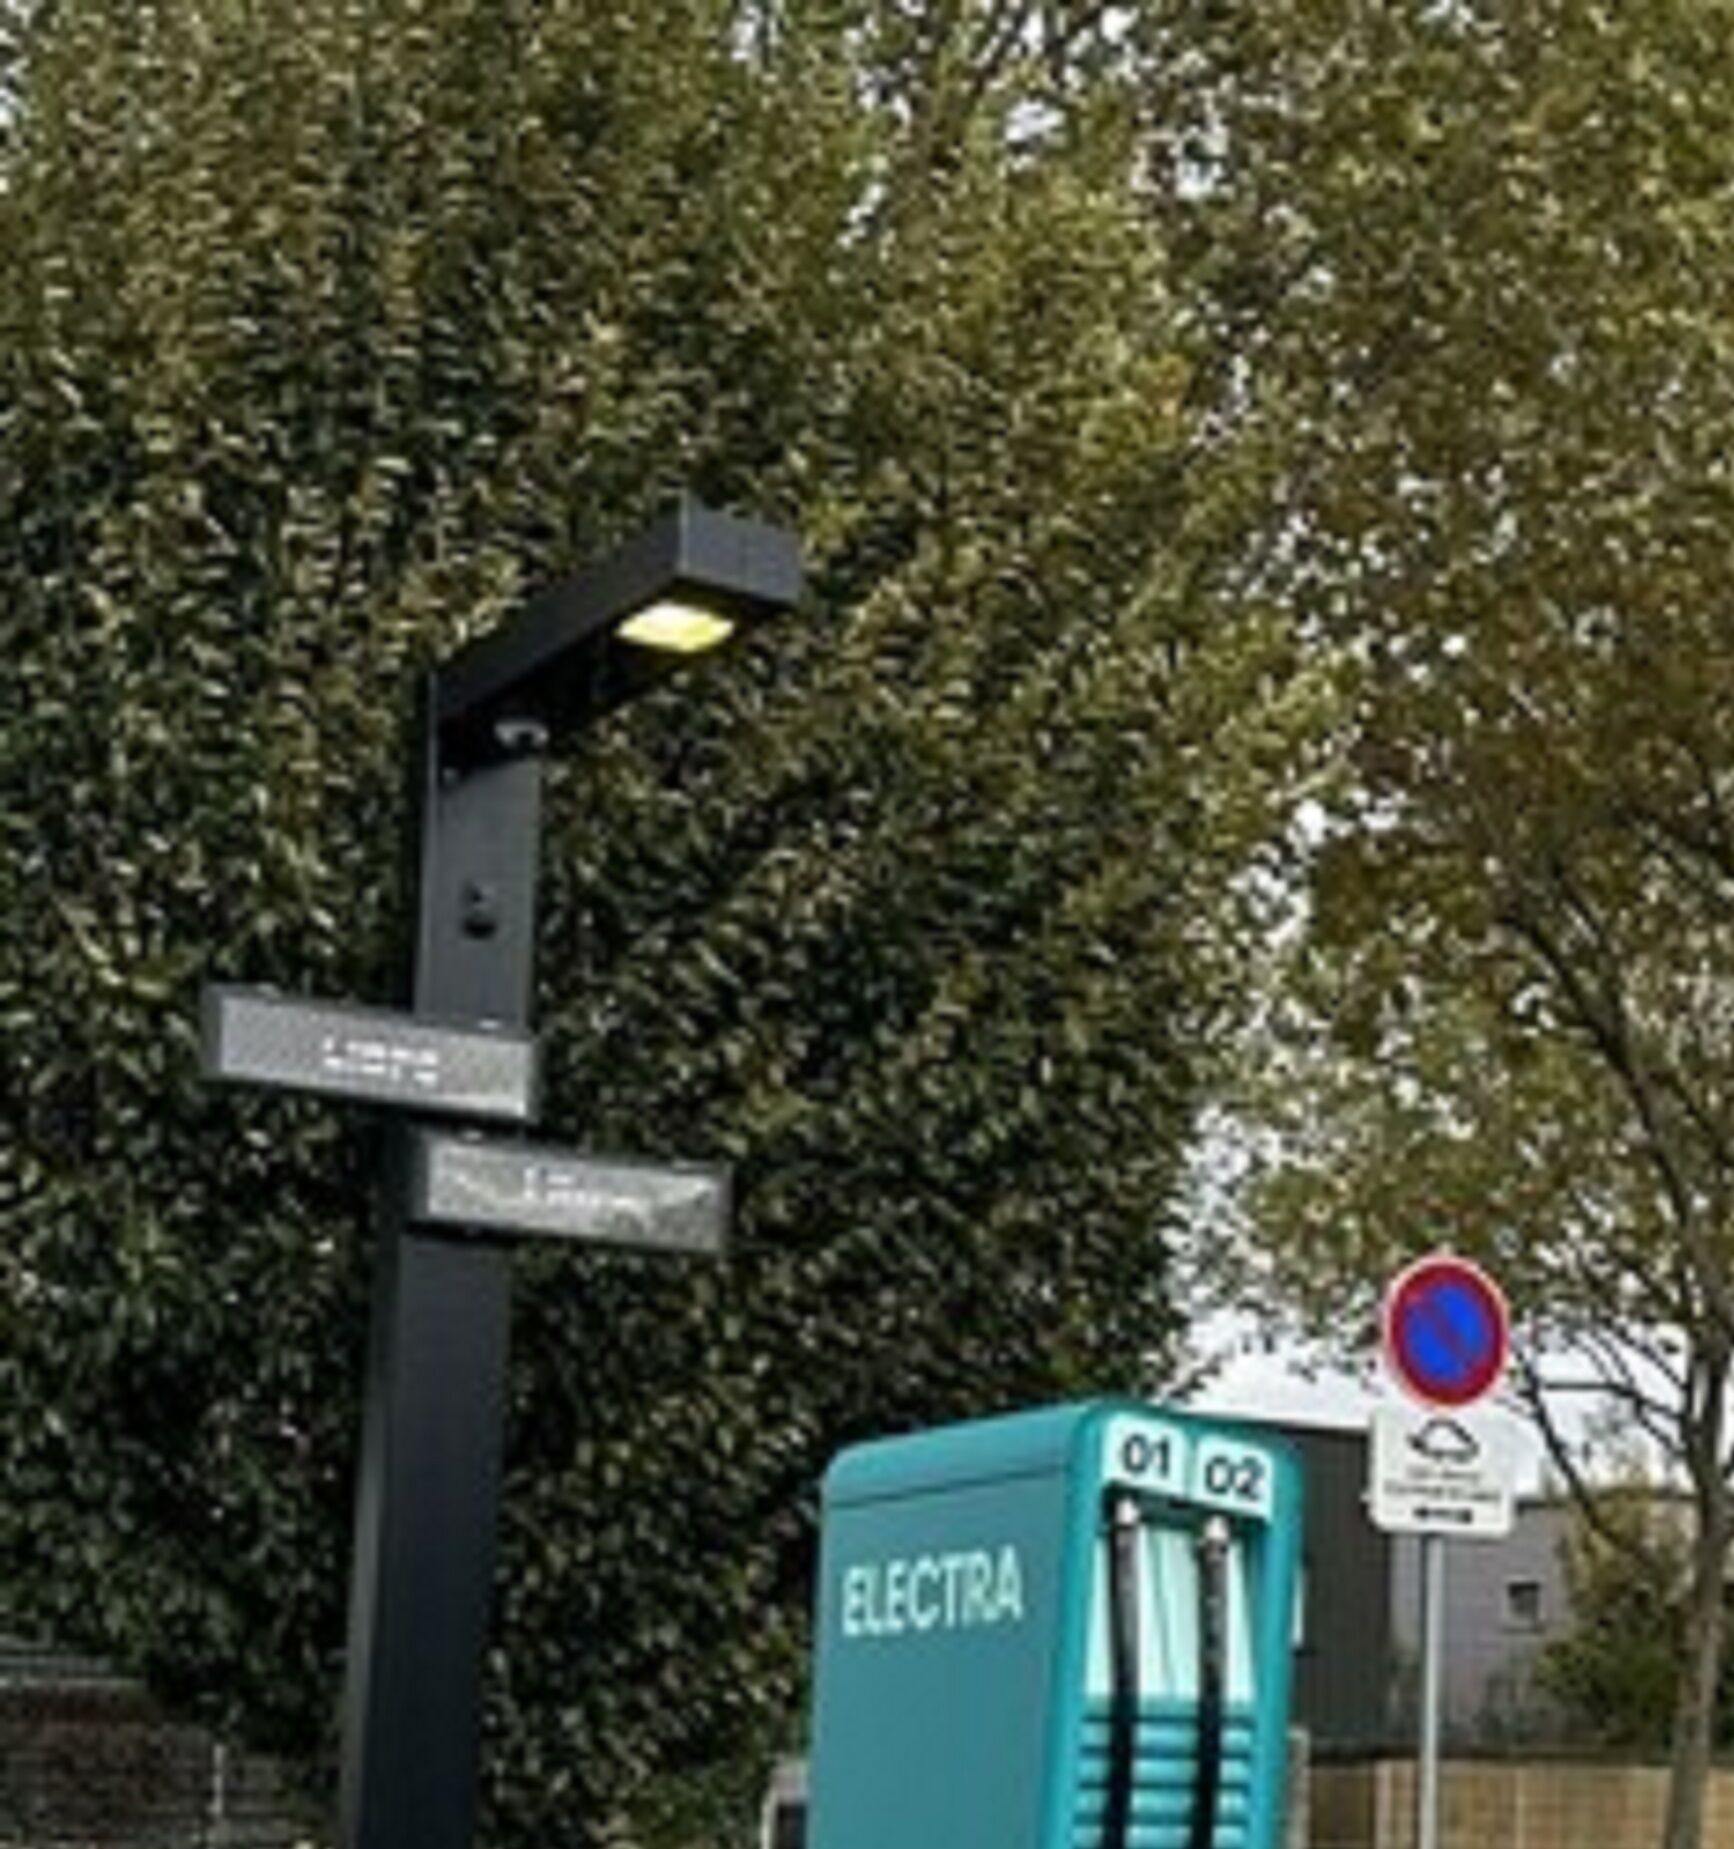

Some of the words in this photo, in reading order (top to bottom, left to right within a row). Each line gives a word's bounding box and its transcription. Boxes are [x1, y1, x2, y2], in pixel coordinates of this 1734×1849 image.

[1123, 1433, 1172, 1477] 01
[1205, 1456, 1265, 1501] 02
[841, 1545, 1024, 1637] ELECTRA
